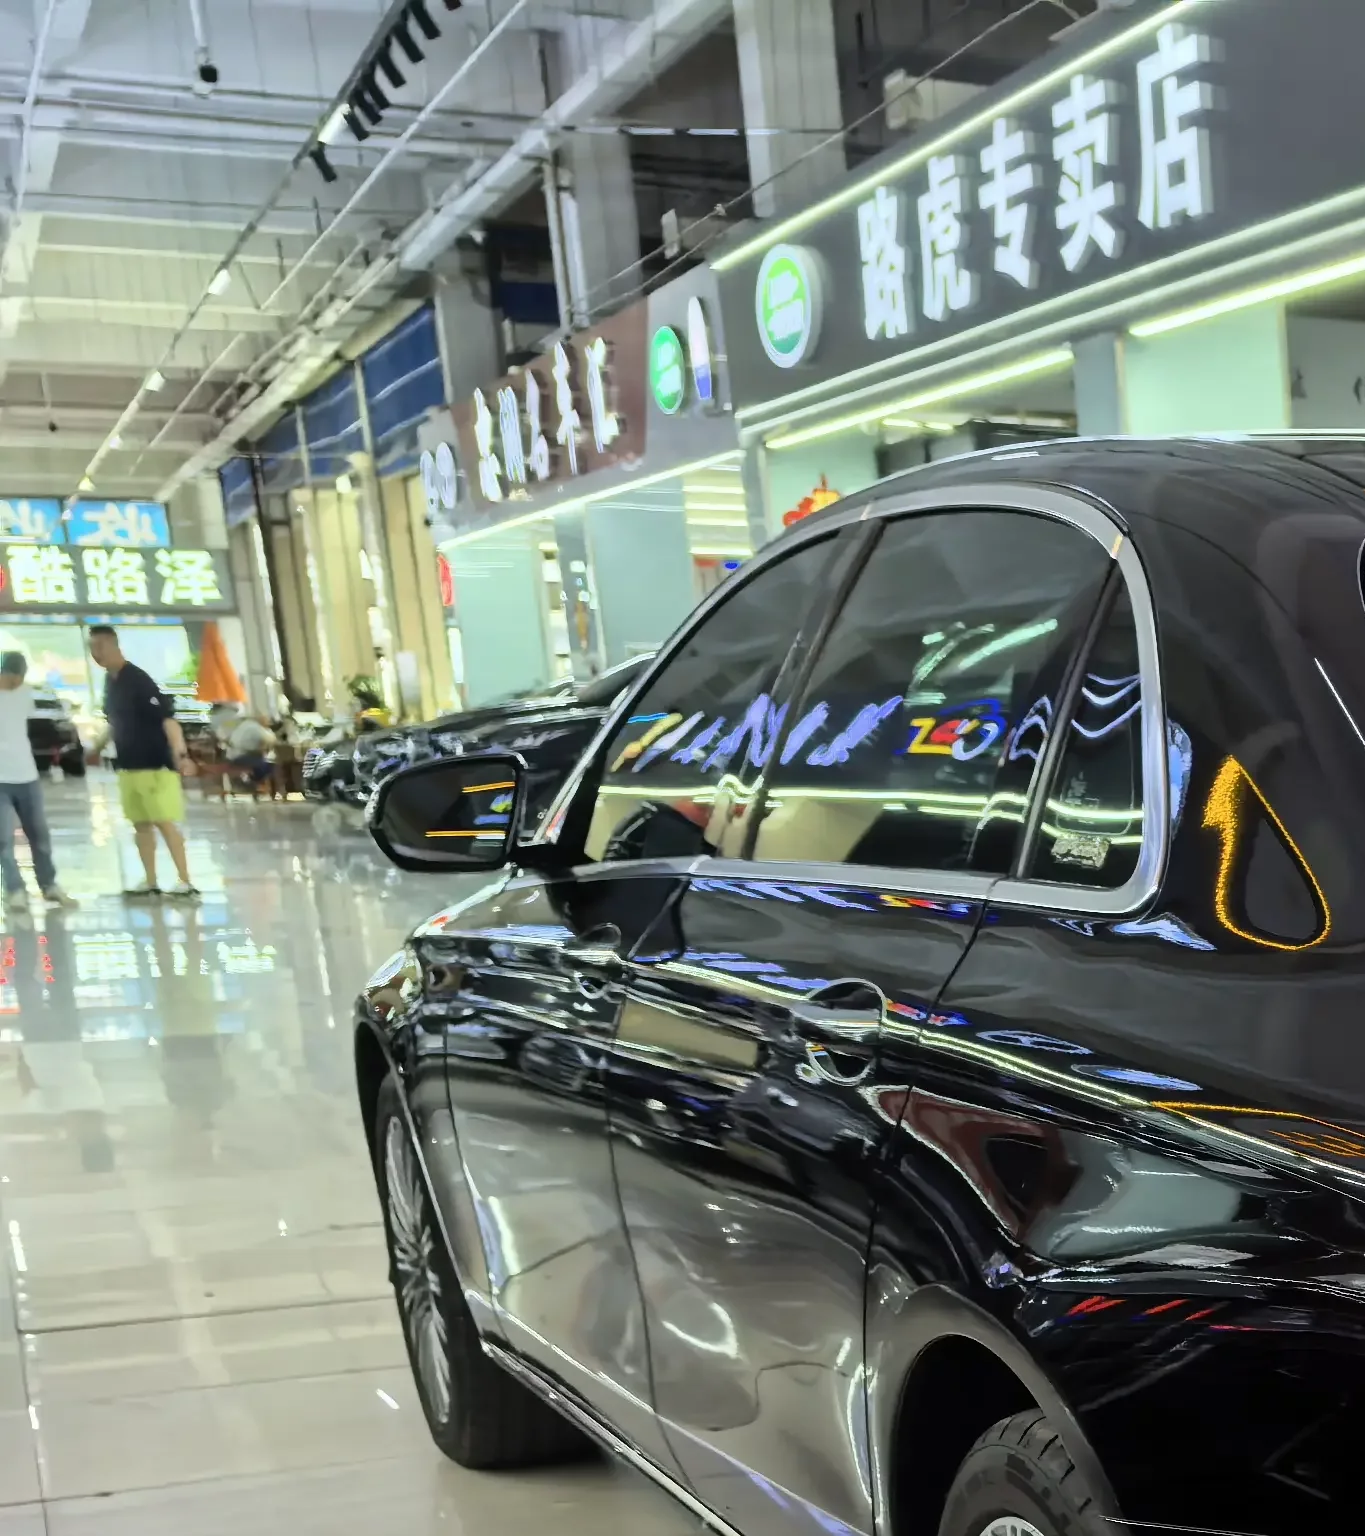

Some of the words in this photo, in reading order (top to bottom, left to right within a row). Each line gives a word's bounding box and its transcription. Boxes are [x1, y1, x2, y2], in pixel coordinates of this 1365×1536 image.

[857, 22, 1212, 340] 路虎专卖店
[7, 546, 223, 605] 酷路泽
